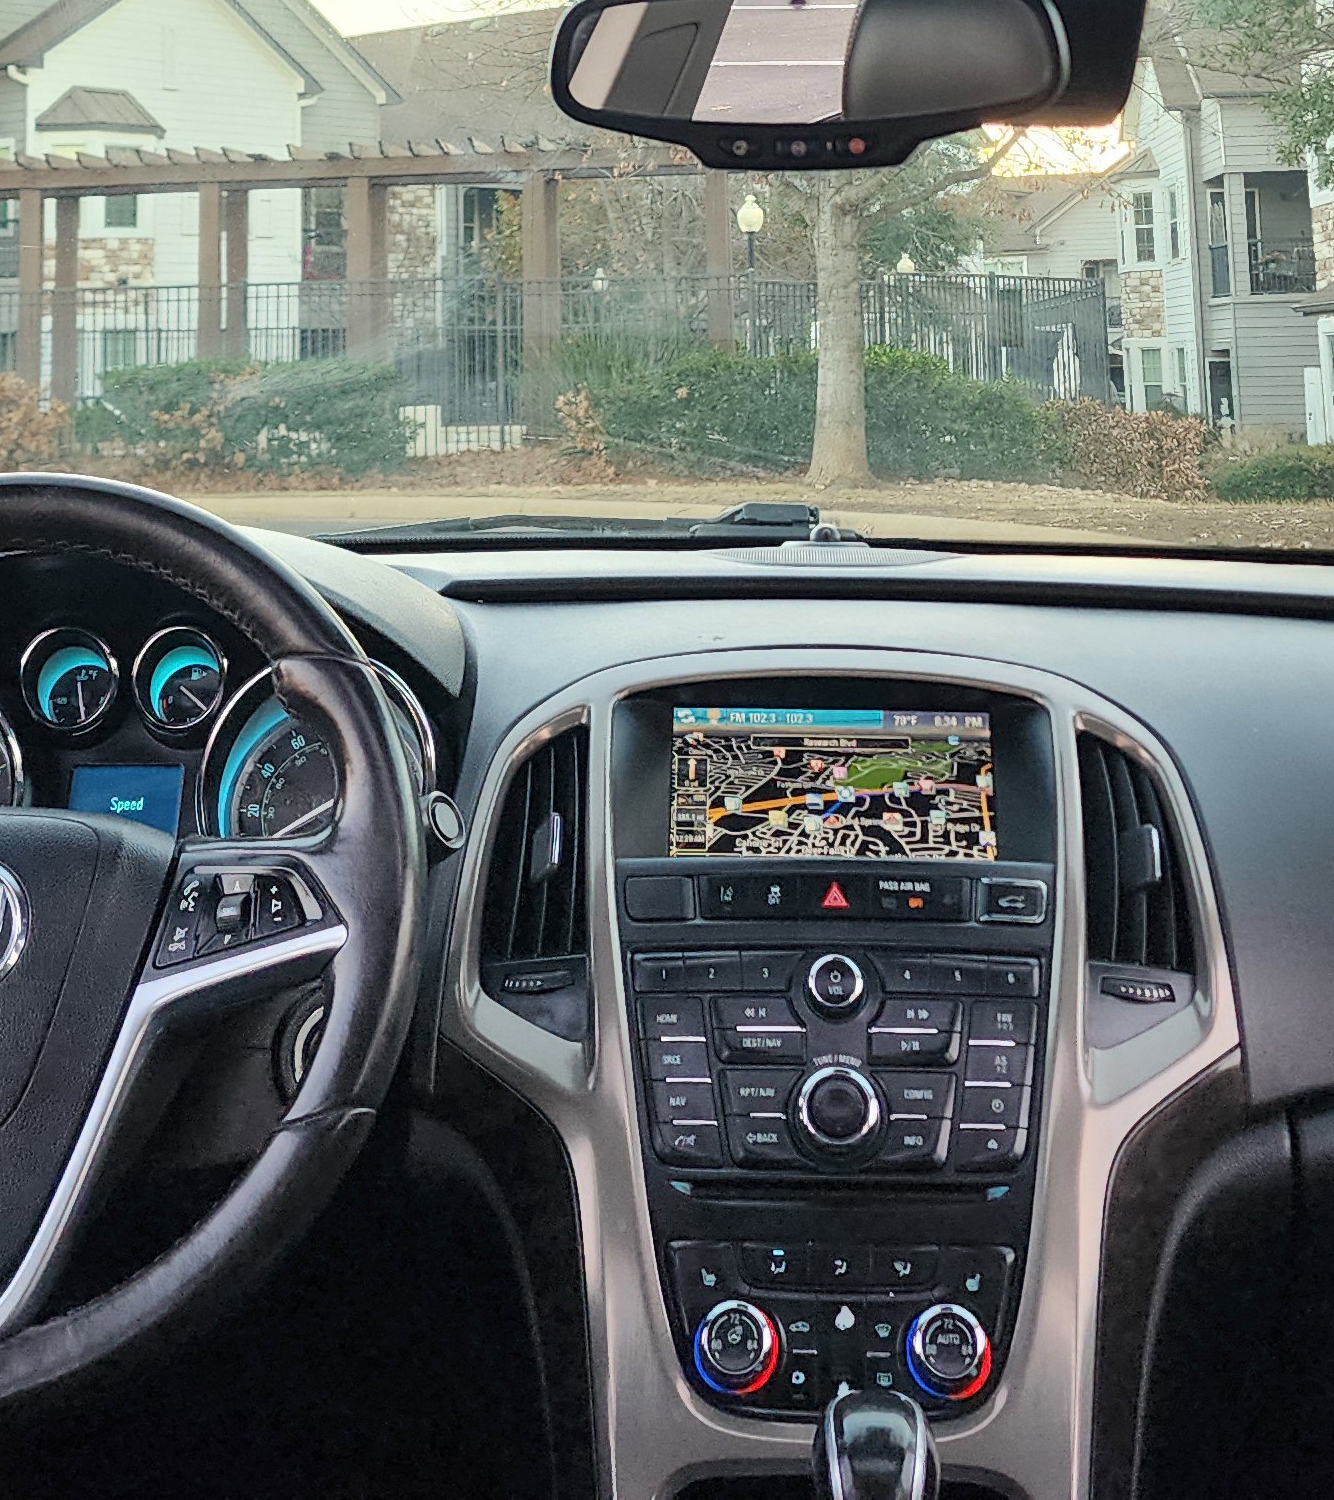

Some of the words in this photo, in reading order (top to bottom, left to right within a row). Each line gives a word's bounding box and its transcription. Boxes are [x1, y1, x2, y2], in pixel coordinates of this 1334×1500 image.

[730, 713, 746, 723] FM
[749, 713, 776, 723] 102.3
[786, 713, 814, 724] 102.3
[965, 716, 983, 728] PM
[291, 735, 306, 750] 60
[261, 763, 275, 779] 40
[110, 796, 144, 813] Speed
[247, 803, 260, 818] 20
[878, 880, 899, 891] PASS
[900, 881, 913, 891] AIR
[914, 882, 931, 892] BAG
[662, 969, 666, 980] 1
[708, 968, 715, 979] 2
[762, 967, 768, 978] 3
[903, 969, 911, 980] 4
[954, 970, 962, 982] 5
[828, 986, 844, 996] VOL
[656, 1014, 678, 1024] HOME
[742, 1038, 782, 1048] DEST/NAV
[669, 1096, 687, 1106] NAV
[757, 1133, 778, 1143] BACK
[730, 1312, 741, 1325] 72
[943, 1318, 954, 1329] 72
[937, 1333, 960, 1345] AUTO
